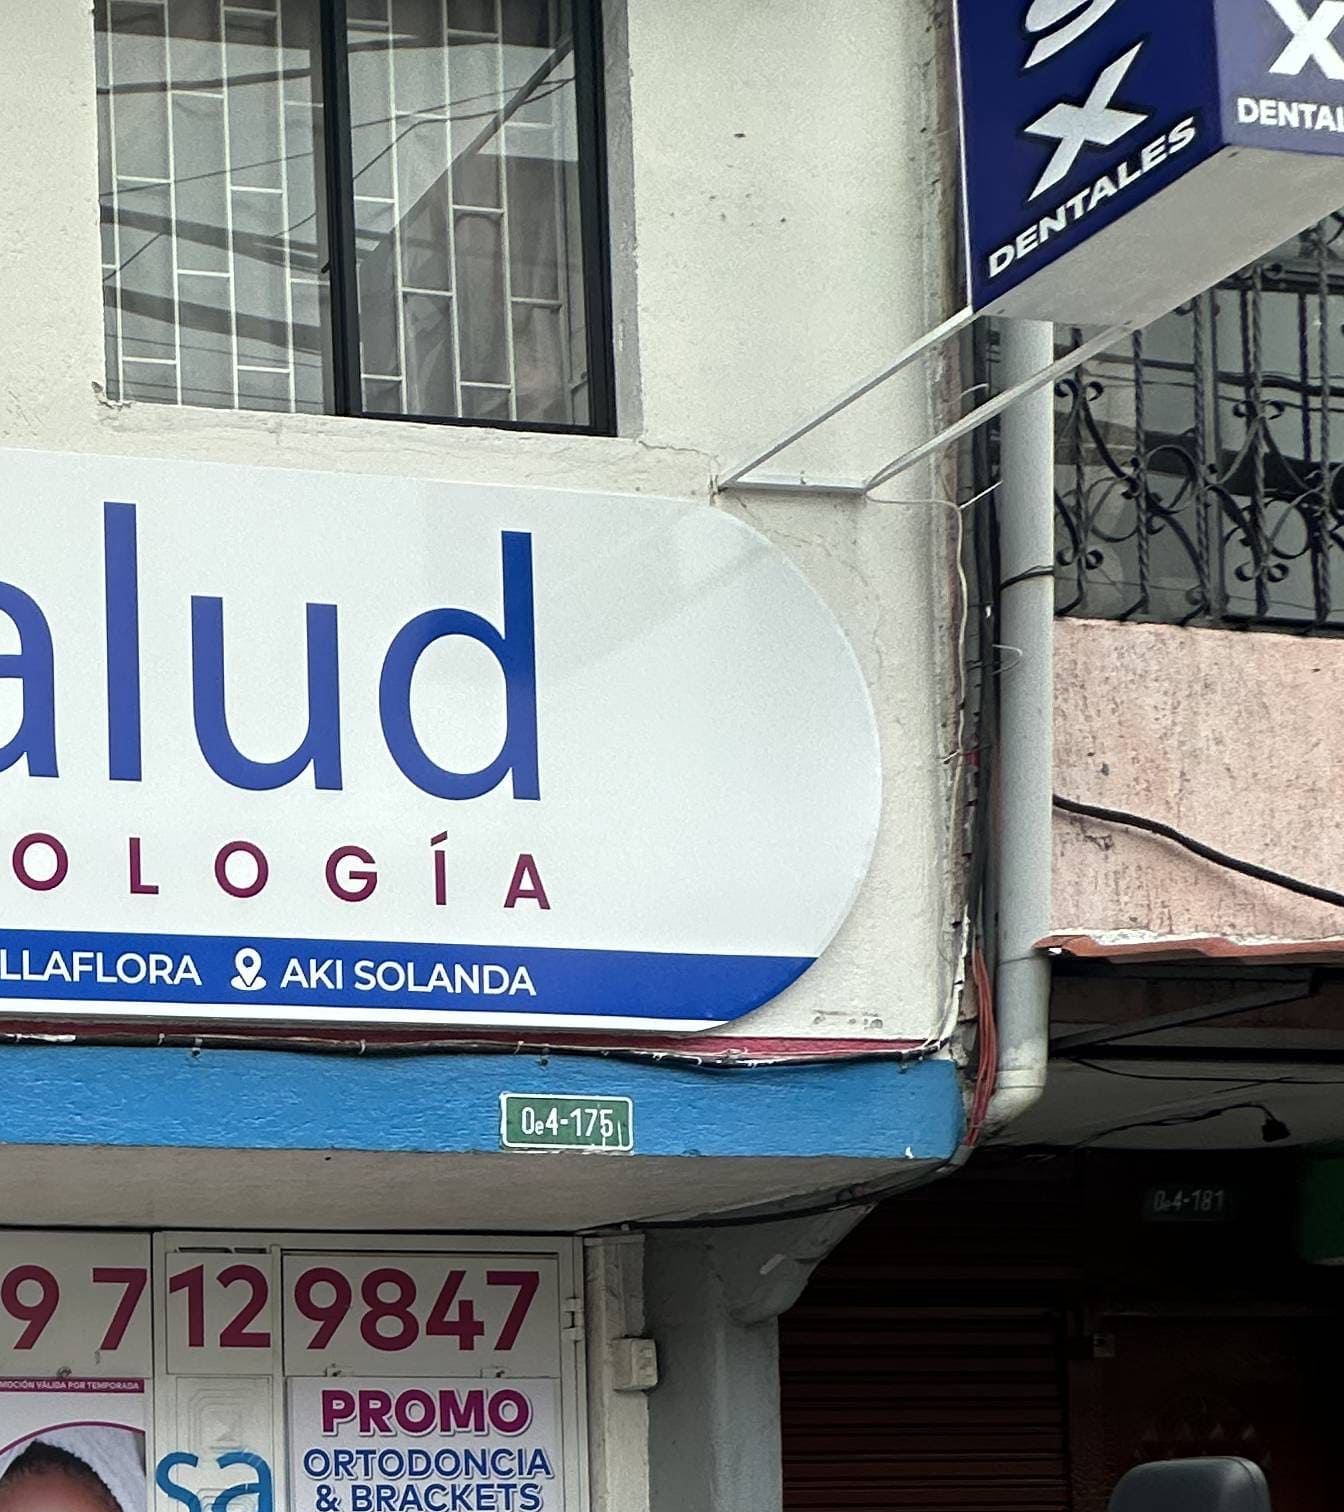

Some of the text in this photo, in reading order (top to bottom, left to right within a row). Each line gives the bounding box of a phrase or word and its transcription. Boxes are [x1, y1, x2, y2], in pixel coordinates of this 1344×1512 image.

[989, 116, 1196, 279] DENTALES
[280, 958, 537, 997] AKI SOLANDA
[294, 1267, 539, 1353] 9847
[321, 1388, 533, 1436] PROMO
[303, 1447, 552, 1479] ORTODONCIA
[315, 1483, 543, 1512] & BRACKETS
